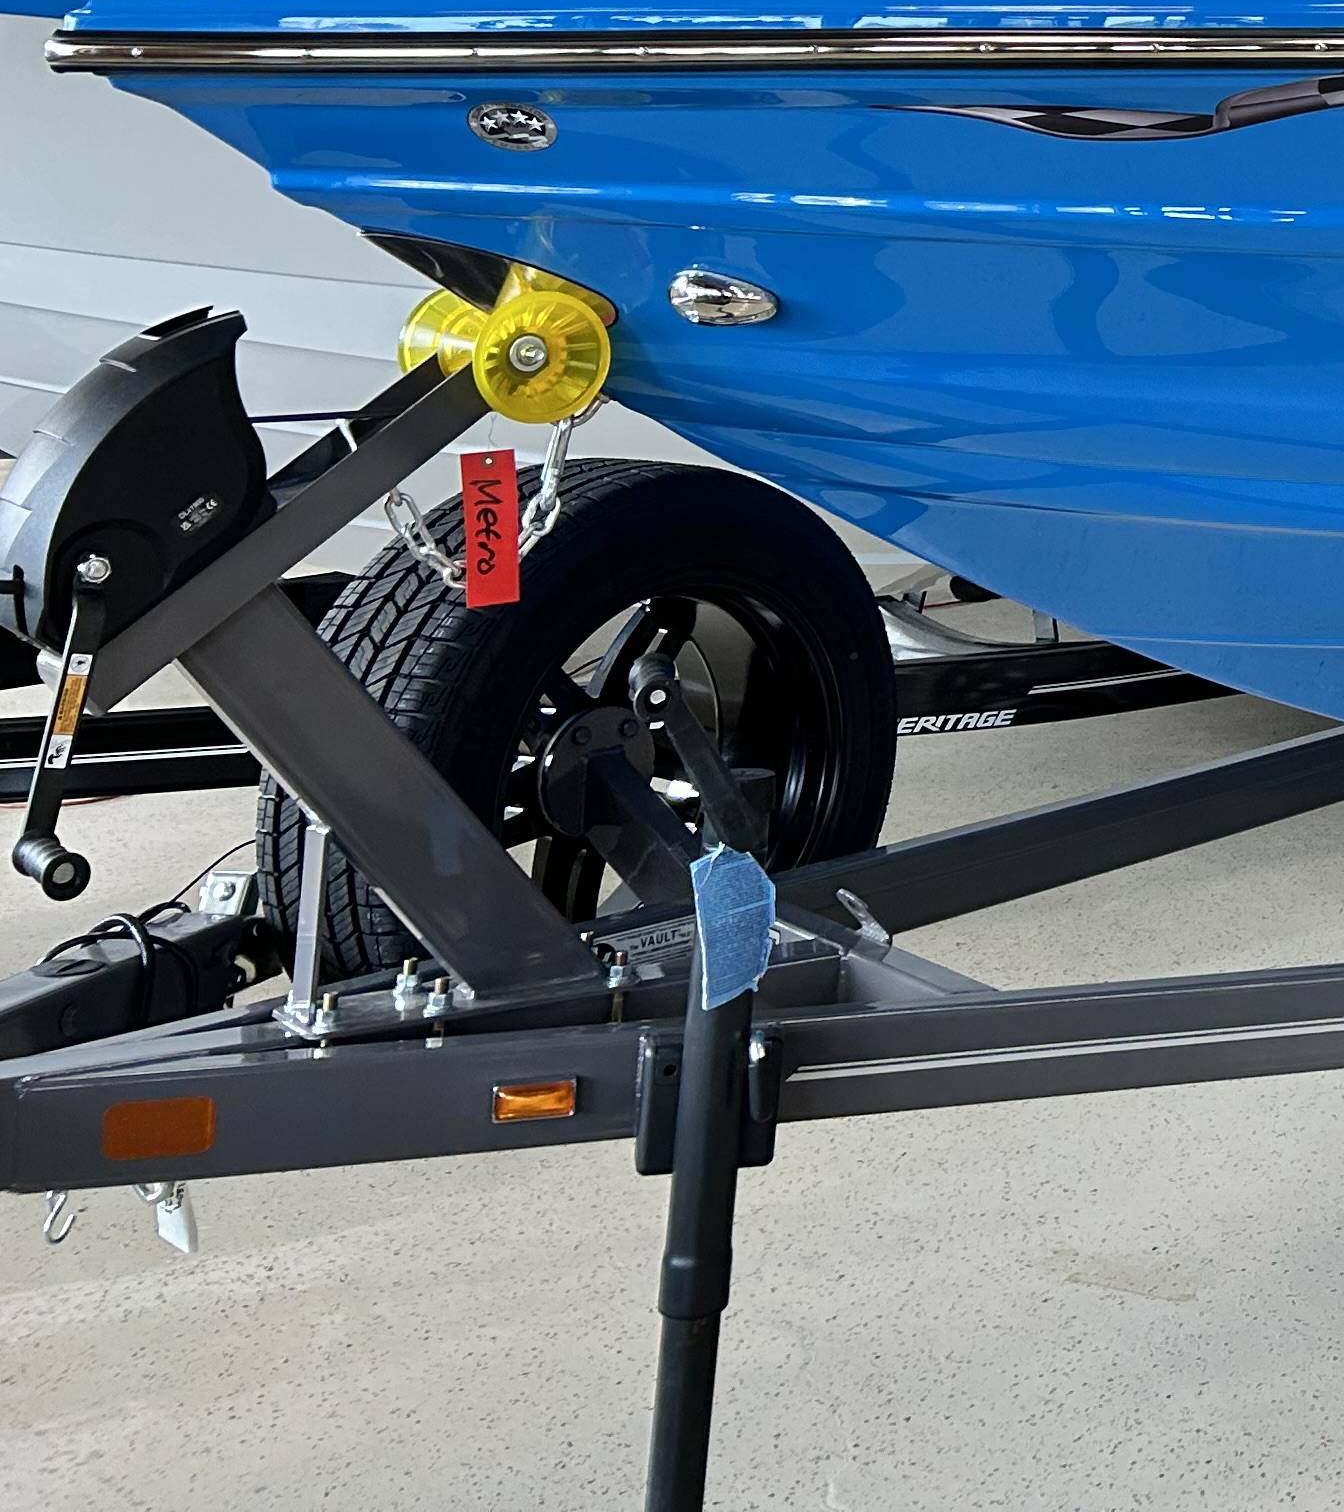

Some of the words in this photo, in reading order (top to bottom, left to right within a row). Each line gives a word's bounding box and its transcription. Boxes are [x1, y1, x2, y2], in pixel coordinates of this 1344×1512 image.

[469, 479, 503, 575] Metro
[897, 708, 1018, 735] ERITAGE
[640, 929, 679, 949] VAULT
